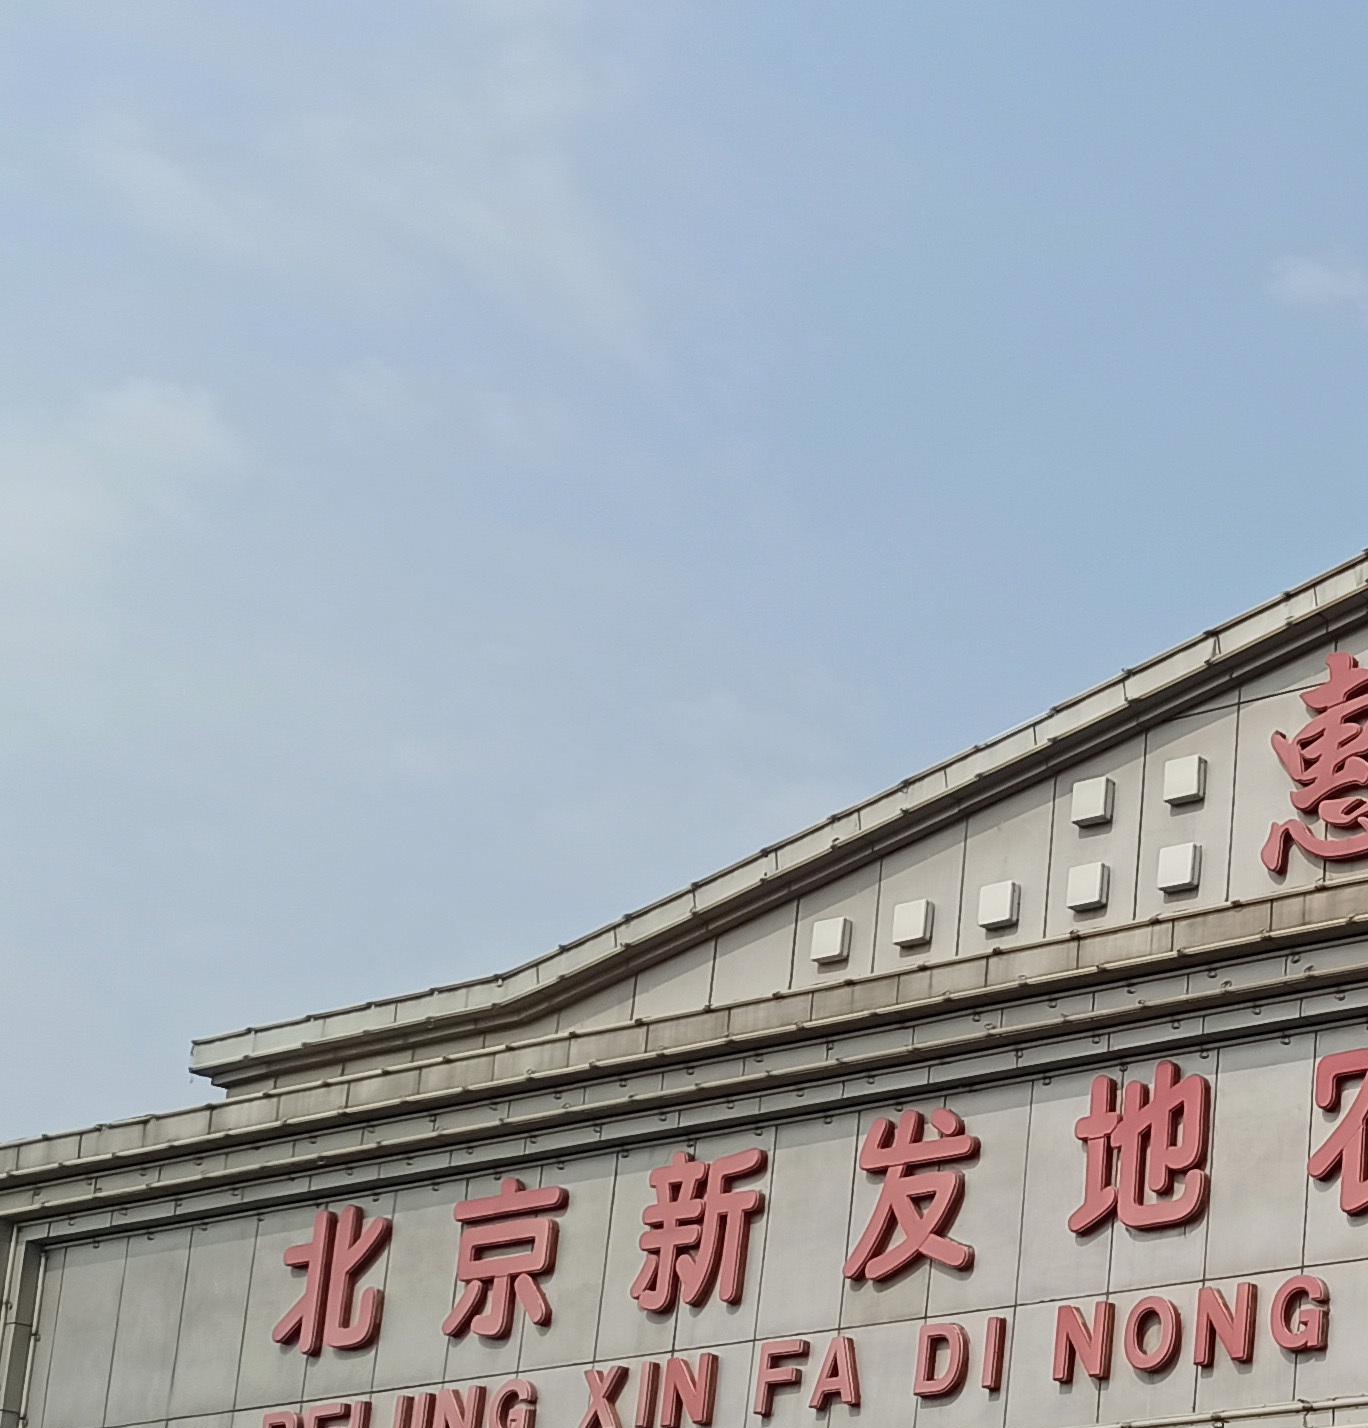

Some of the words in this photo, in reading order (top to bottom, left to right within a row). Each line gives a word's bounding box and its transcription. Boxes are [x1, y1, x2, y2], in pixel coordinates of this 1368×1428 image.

[753, 1336, 862, 1417] FA
[913, 1316, 1007, 1398] DI
[1052, 1274, 1329, 1383] NONG
